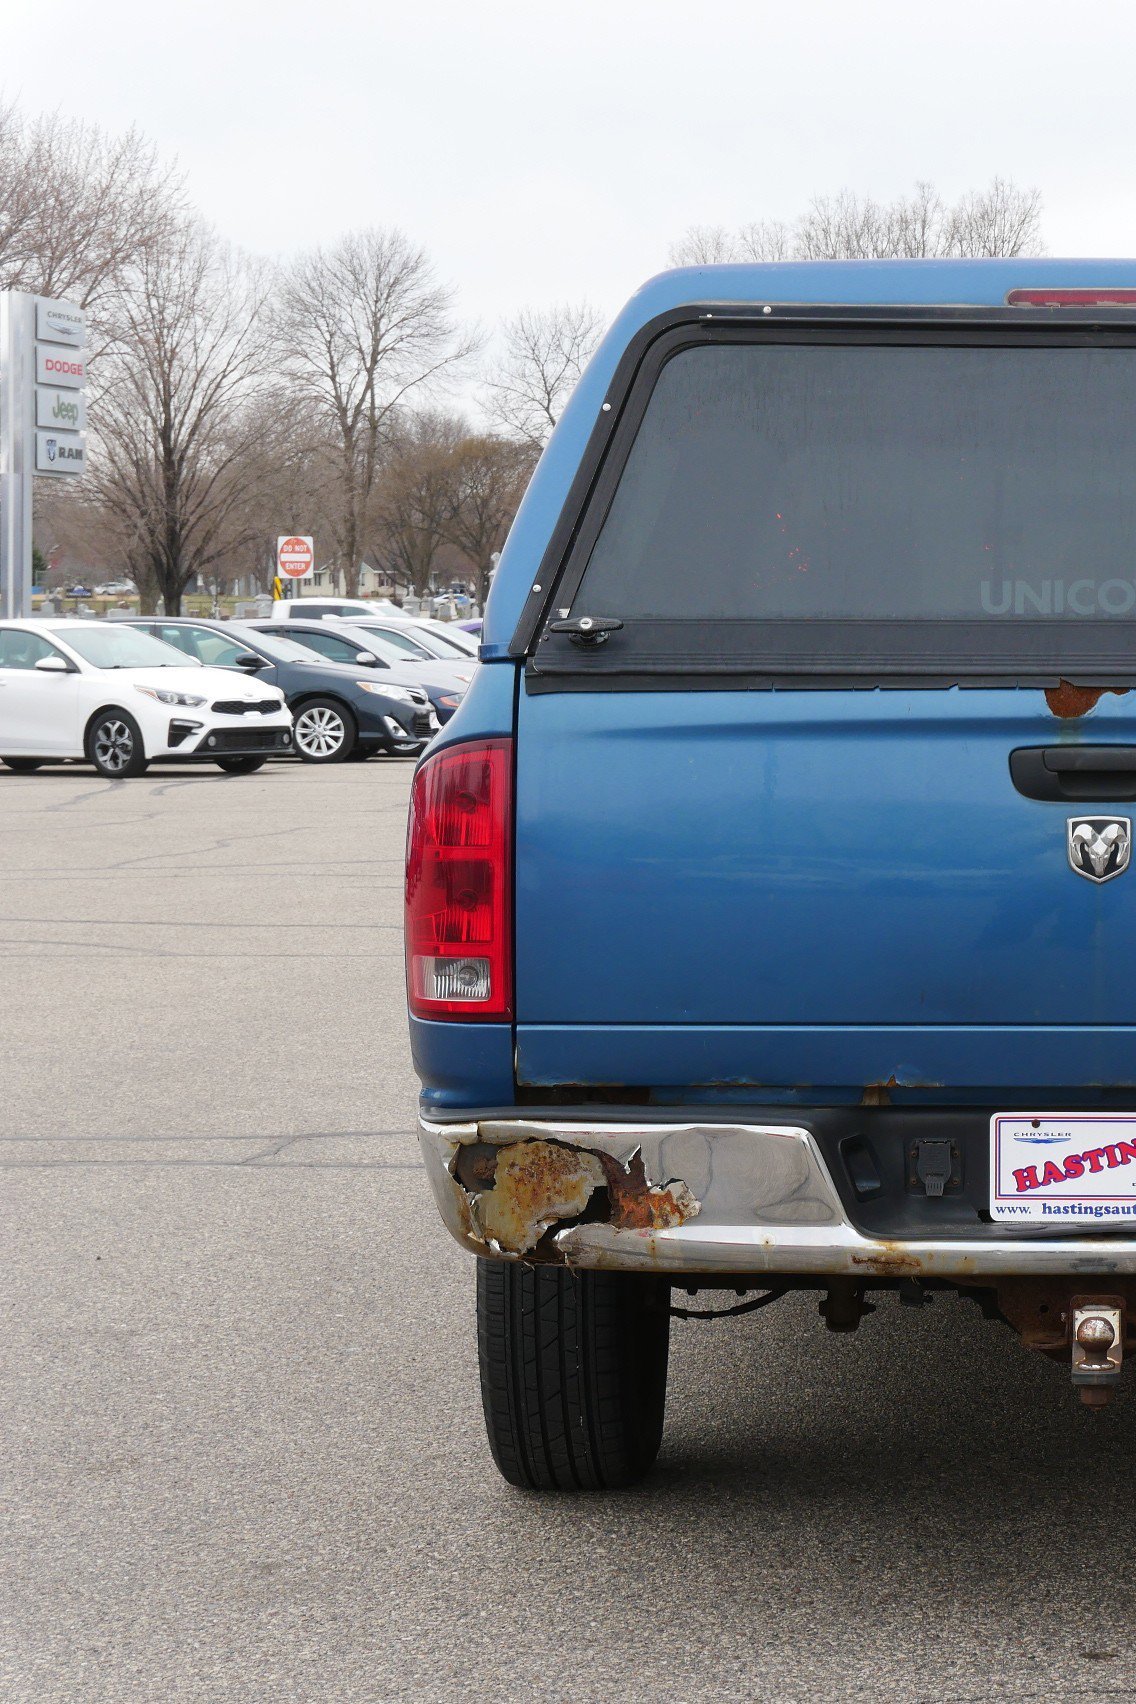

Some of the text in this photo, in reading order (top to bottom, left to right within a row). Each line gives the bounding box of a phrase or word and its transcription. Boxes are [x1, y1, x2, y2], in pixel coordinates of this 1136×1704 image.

[47, 311, 83, 323] CHRYSLER
[45, 359, 83, 376] DODGE
[52, 394, 79, 426] Jeep
[58, 446, 83, 461] RAM
[995, 1206, 1032, 1215] www.
